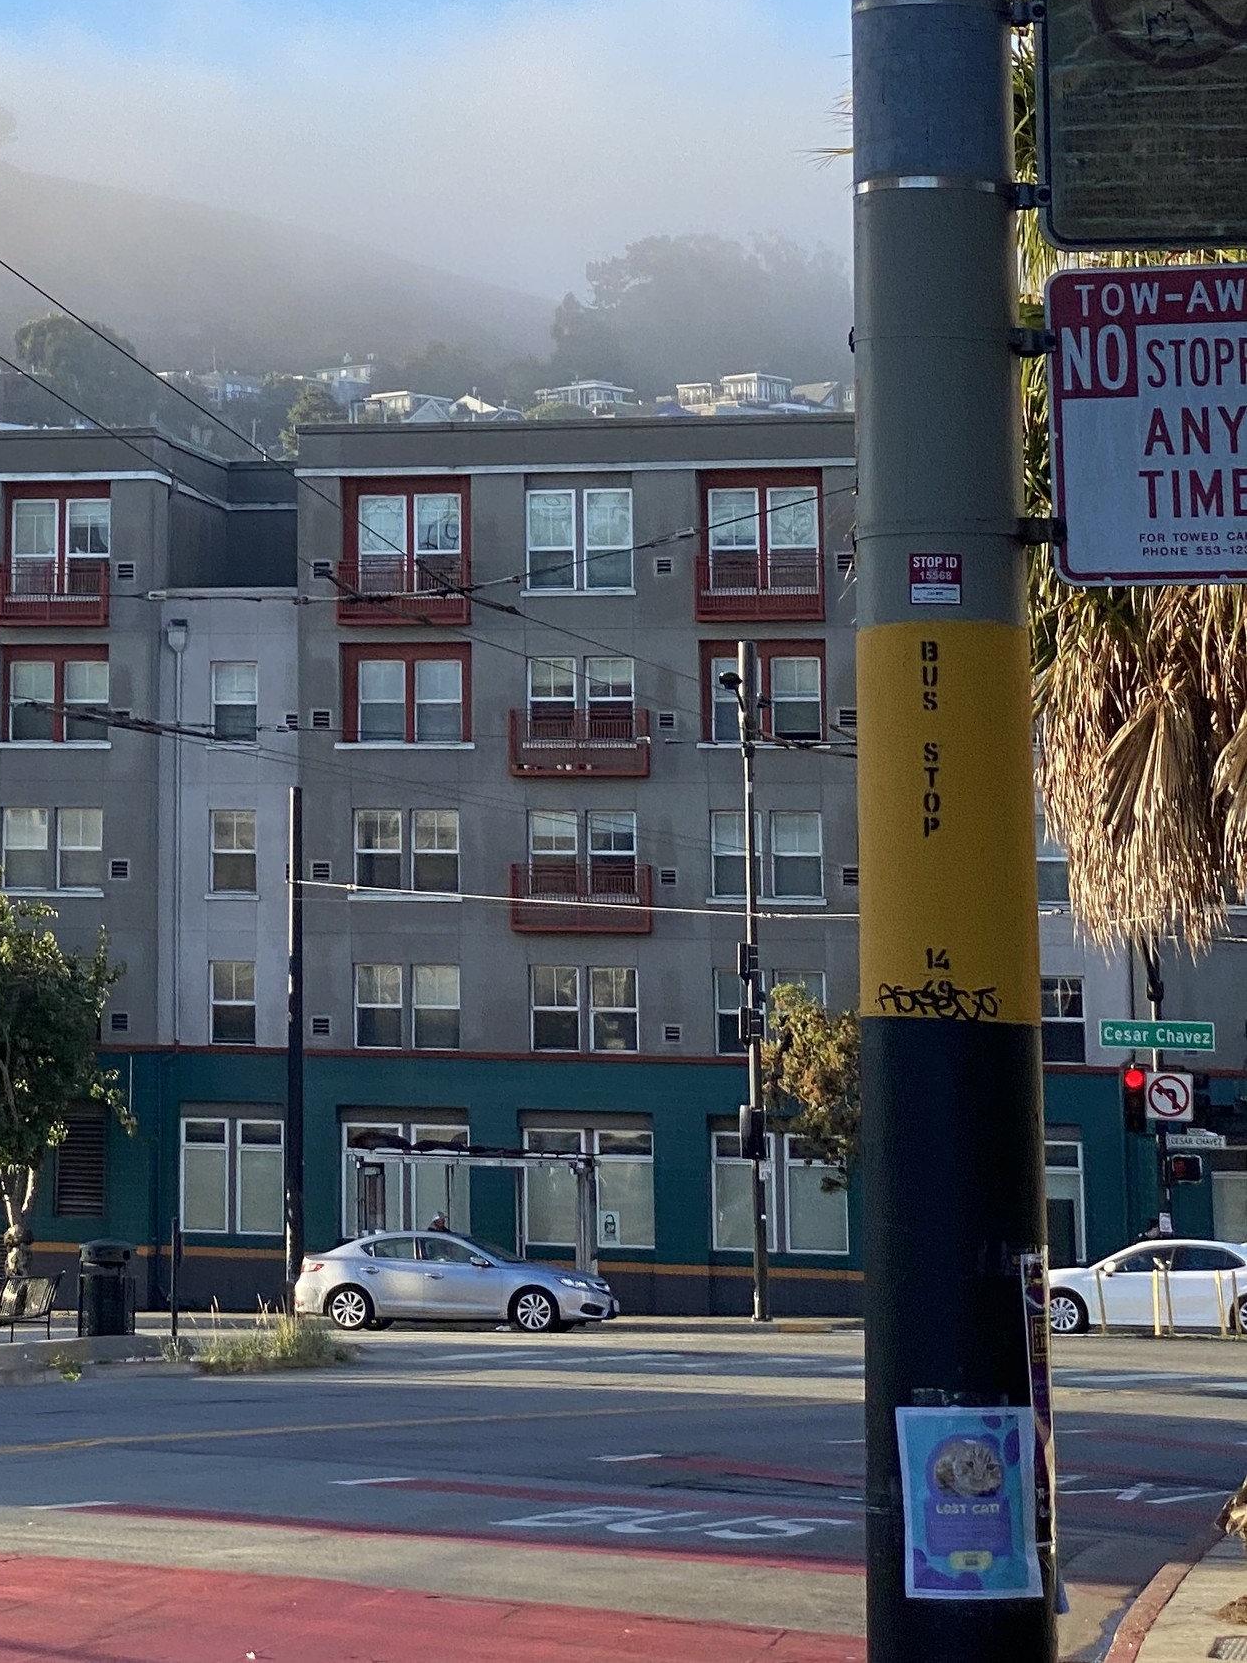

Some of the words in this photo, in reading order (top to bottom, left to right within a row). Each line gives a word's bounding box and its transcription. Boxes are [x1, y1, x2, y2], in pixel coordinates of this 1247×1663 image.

[1073, 278, 1245, 317] TOW-AW
[1061, 324, 1129, 391] NO
[1144, 405, 1247, 457] ANY
[1139, 468, 1247, 519] TIME
[1139, 533, 1165, 543] FOR
[1172, 532, 1219, 542] TOWED
[1142, 546, 1188, 556] PHONE
[912, 556, 943, 568] STOP
[945, 556, 958, 568] ID
[920, 641, 939, 711] BUS
[922, 741, 941, 838] STOP
[925, 947, 950, 970] 14
[1103, 1027, 1149, 1042] Cesar
[1156, 1028, 1211, 1044] Chavez
[488, 1505, 856, 1540] BUS
[936, 1503, 967, 1514] LOST
